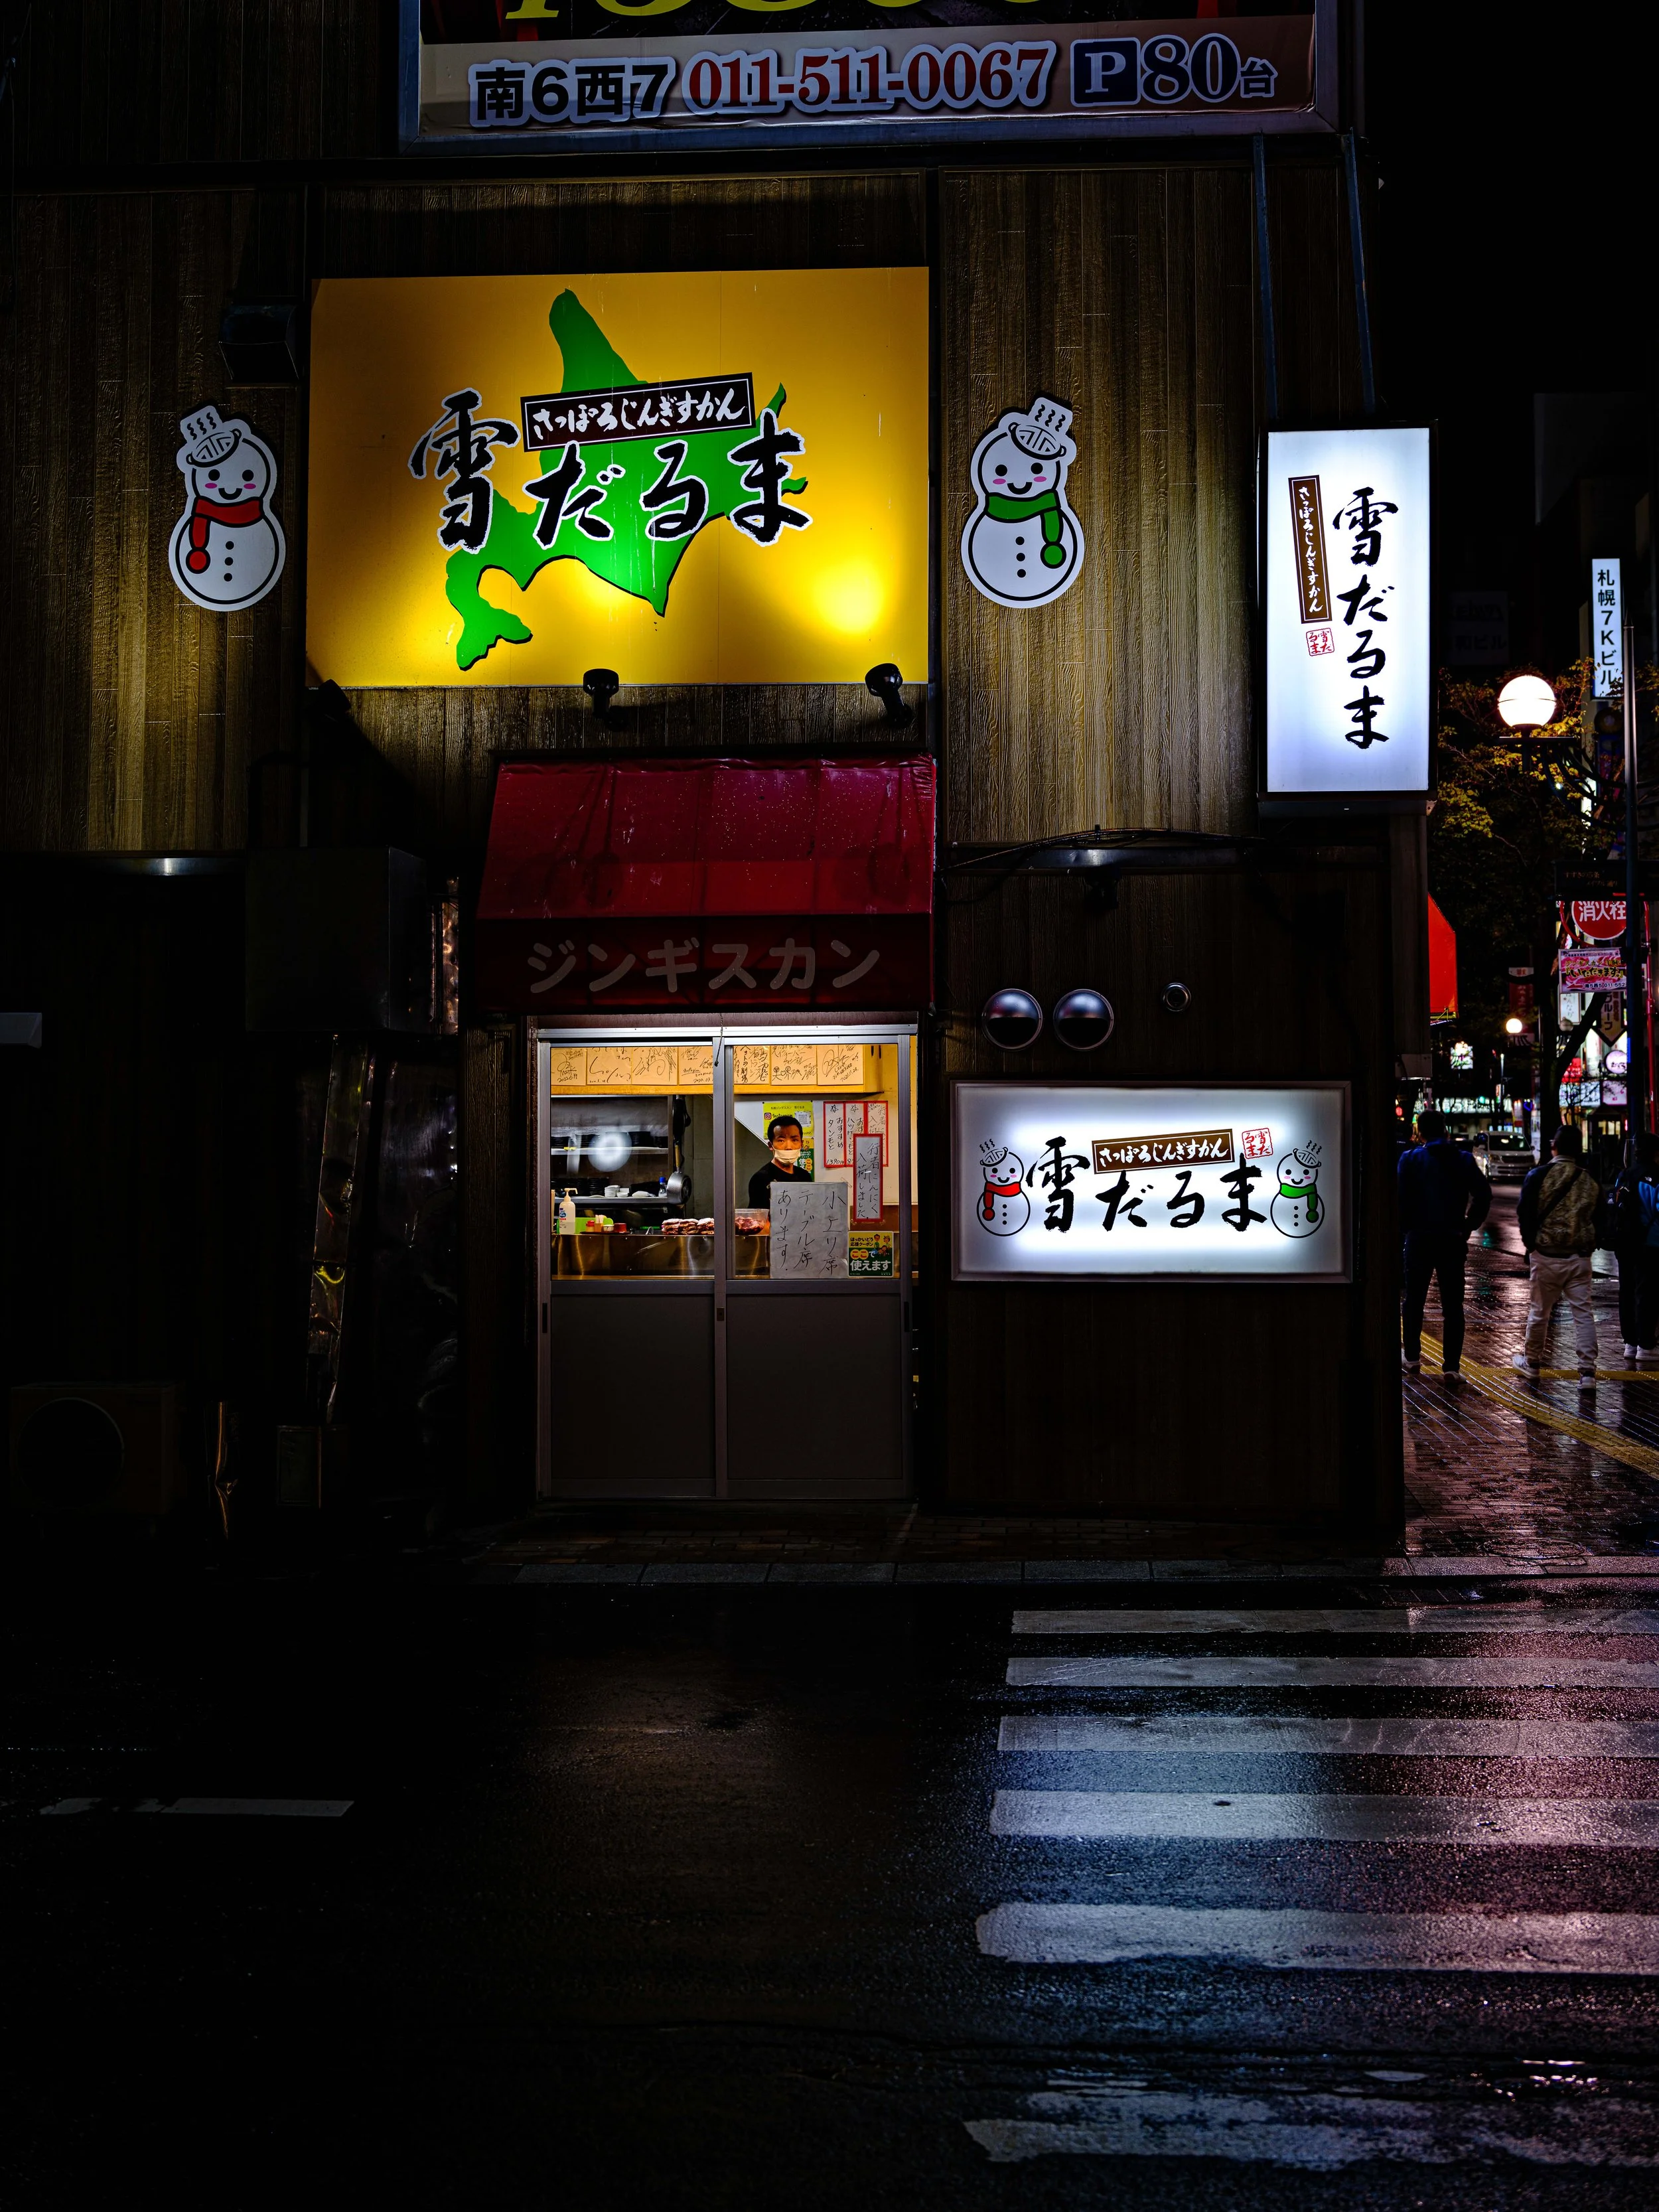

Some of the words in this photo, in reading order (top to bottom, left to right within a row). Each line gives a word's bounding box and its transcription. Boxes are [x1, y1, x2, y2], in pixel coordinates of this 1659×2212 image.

[472, 64, 674, 123] 南6西7
[685, 45, 1052, 111] 011-511-0067
[533, 387, 745, 439] さっぽろじんぎすかん
[409, 388, 812, 553] 雪だるま
[1297, 486, 1324, 614] さっぽろじんぎすかん
[1332, 486, 1399, 750] 雪だるま
[1597, 569, 1617, 686] 札幌7Kビル
[1578, 901, 1626, 922] 消火栓
[527, 936, 881, 994] ジンギスカン
[1026, 1136, 1267, 1233] 雪だるま
[1098, 1138, 1228, 1166] さっぽろじんぎすかん
[850, 1260, 891, 1272] 使えます
